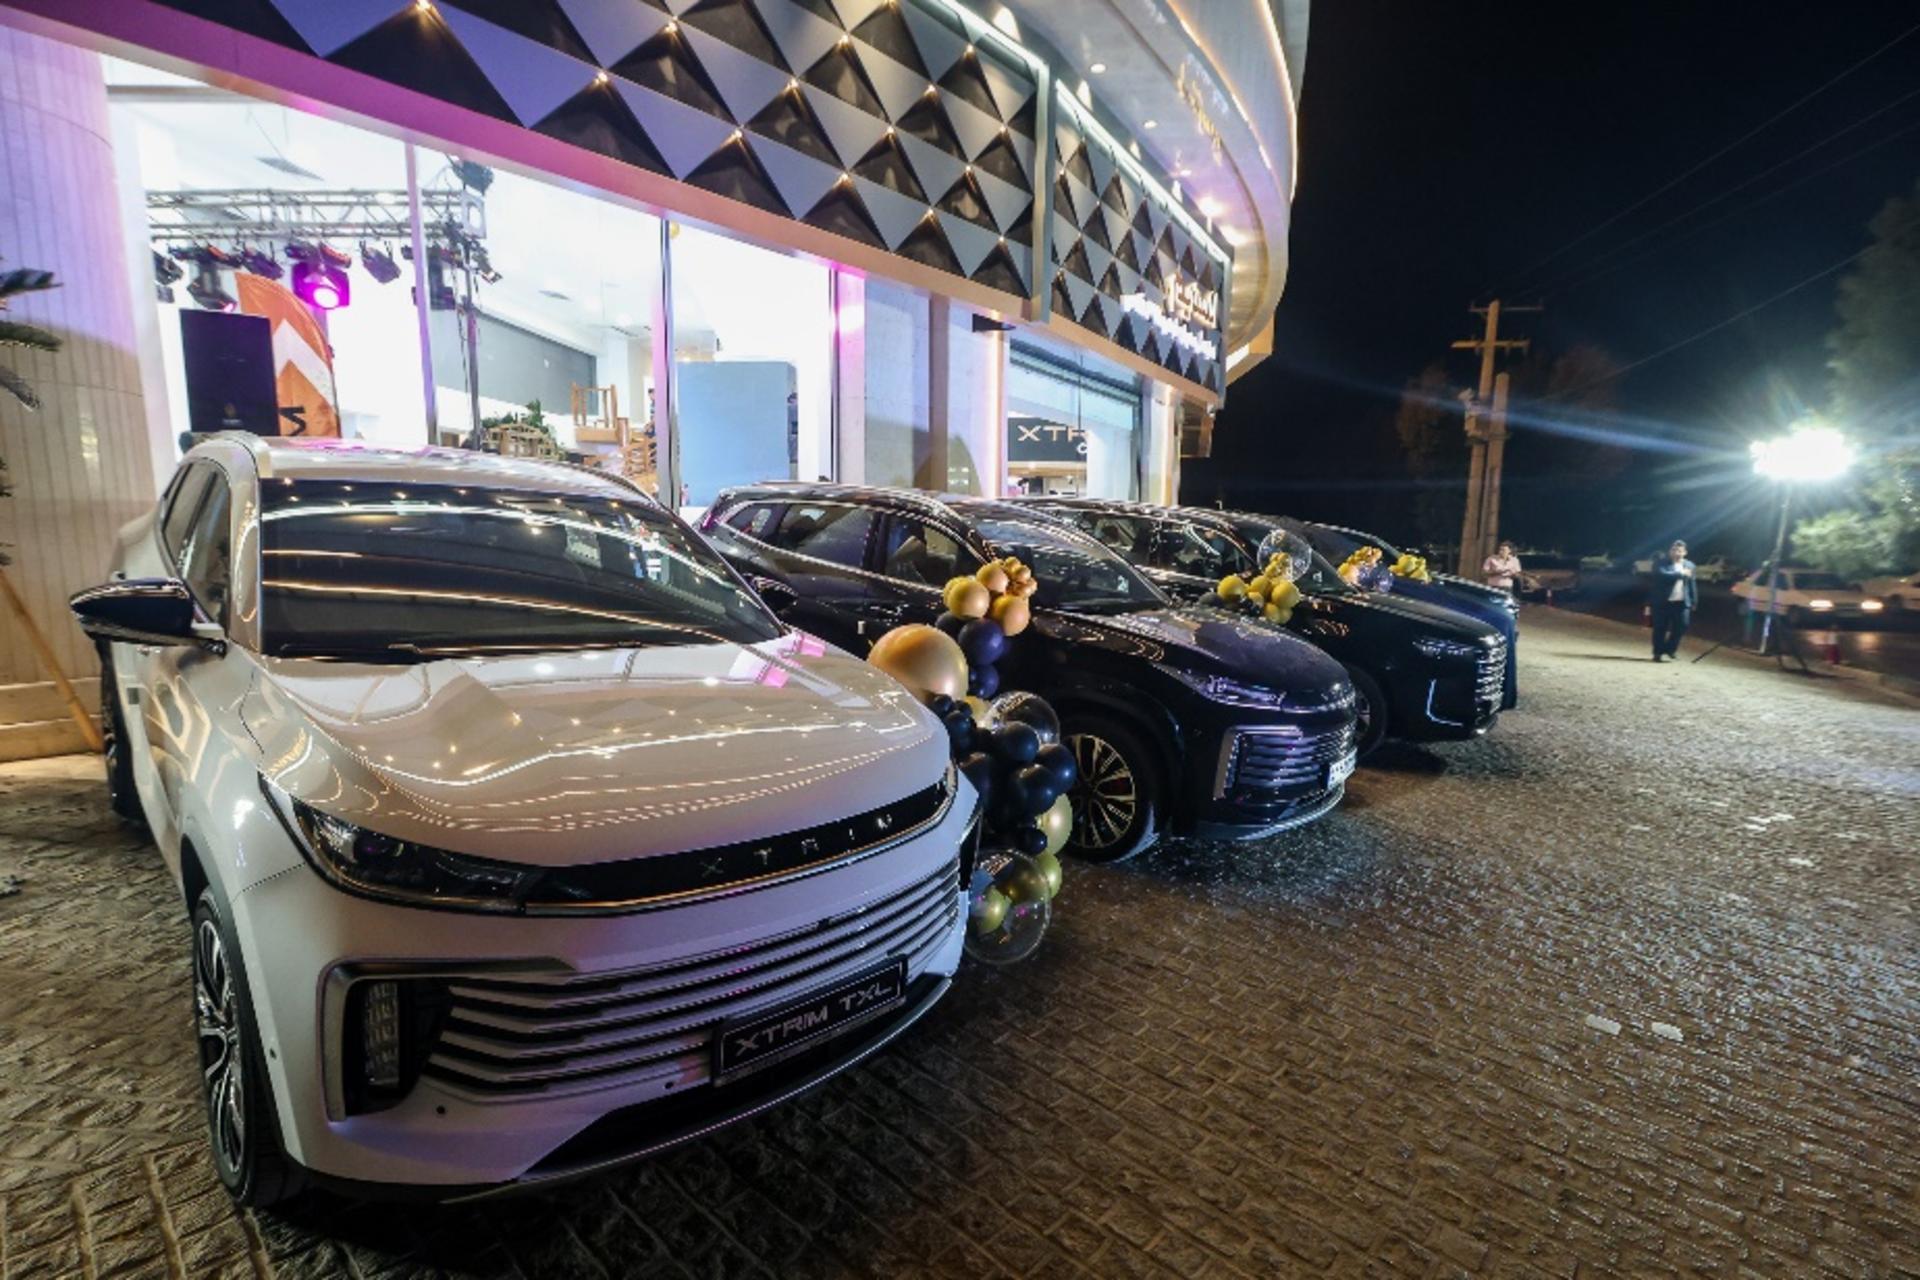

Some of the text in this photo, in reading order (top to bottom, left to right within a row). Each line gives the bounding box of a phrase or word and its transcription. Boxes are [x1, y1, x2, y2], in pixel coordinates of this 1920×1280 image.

[700, 813, 893, 878] XTRIM
[735, 982, 892, 1057] XTRIM TXL
